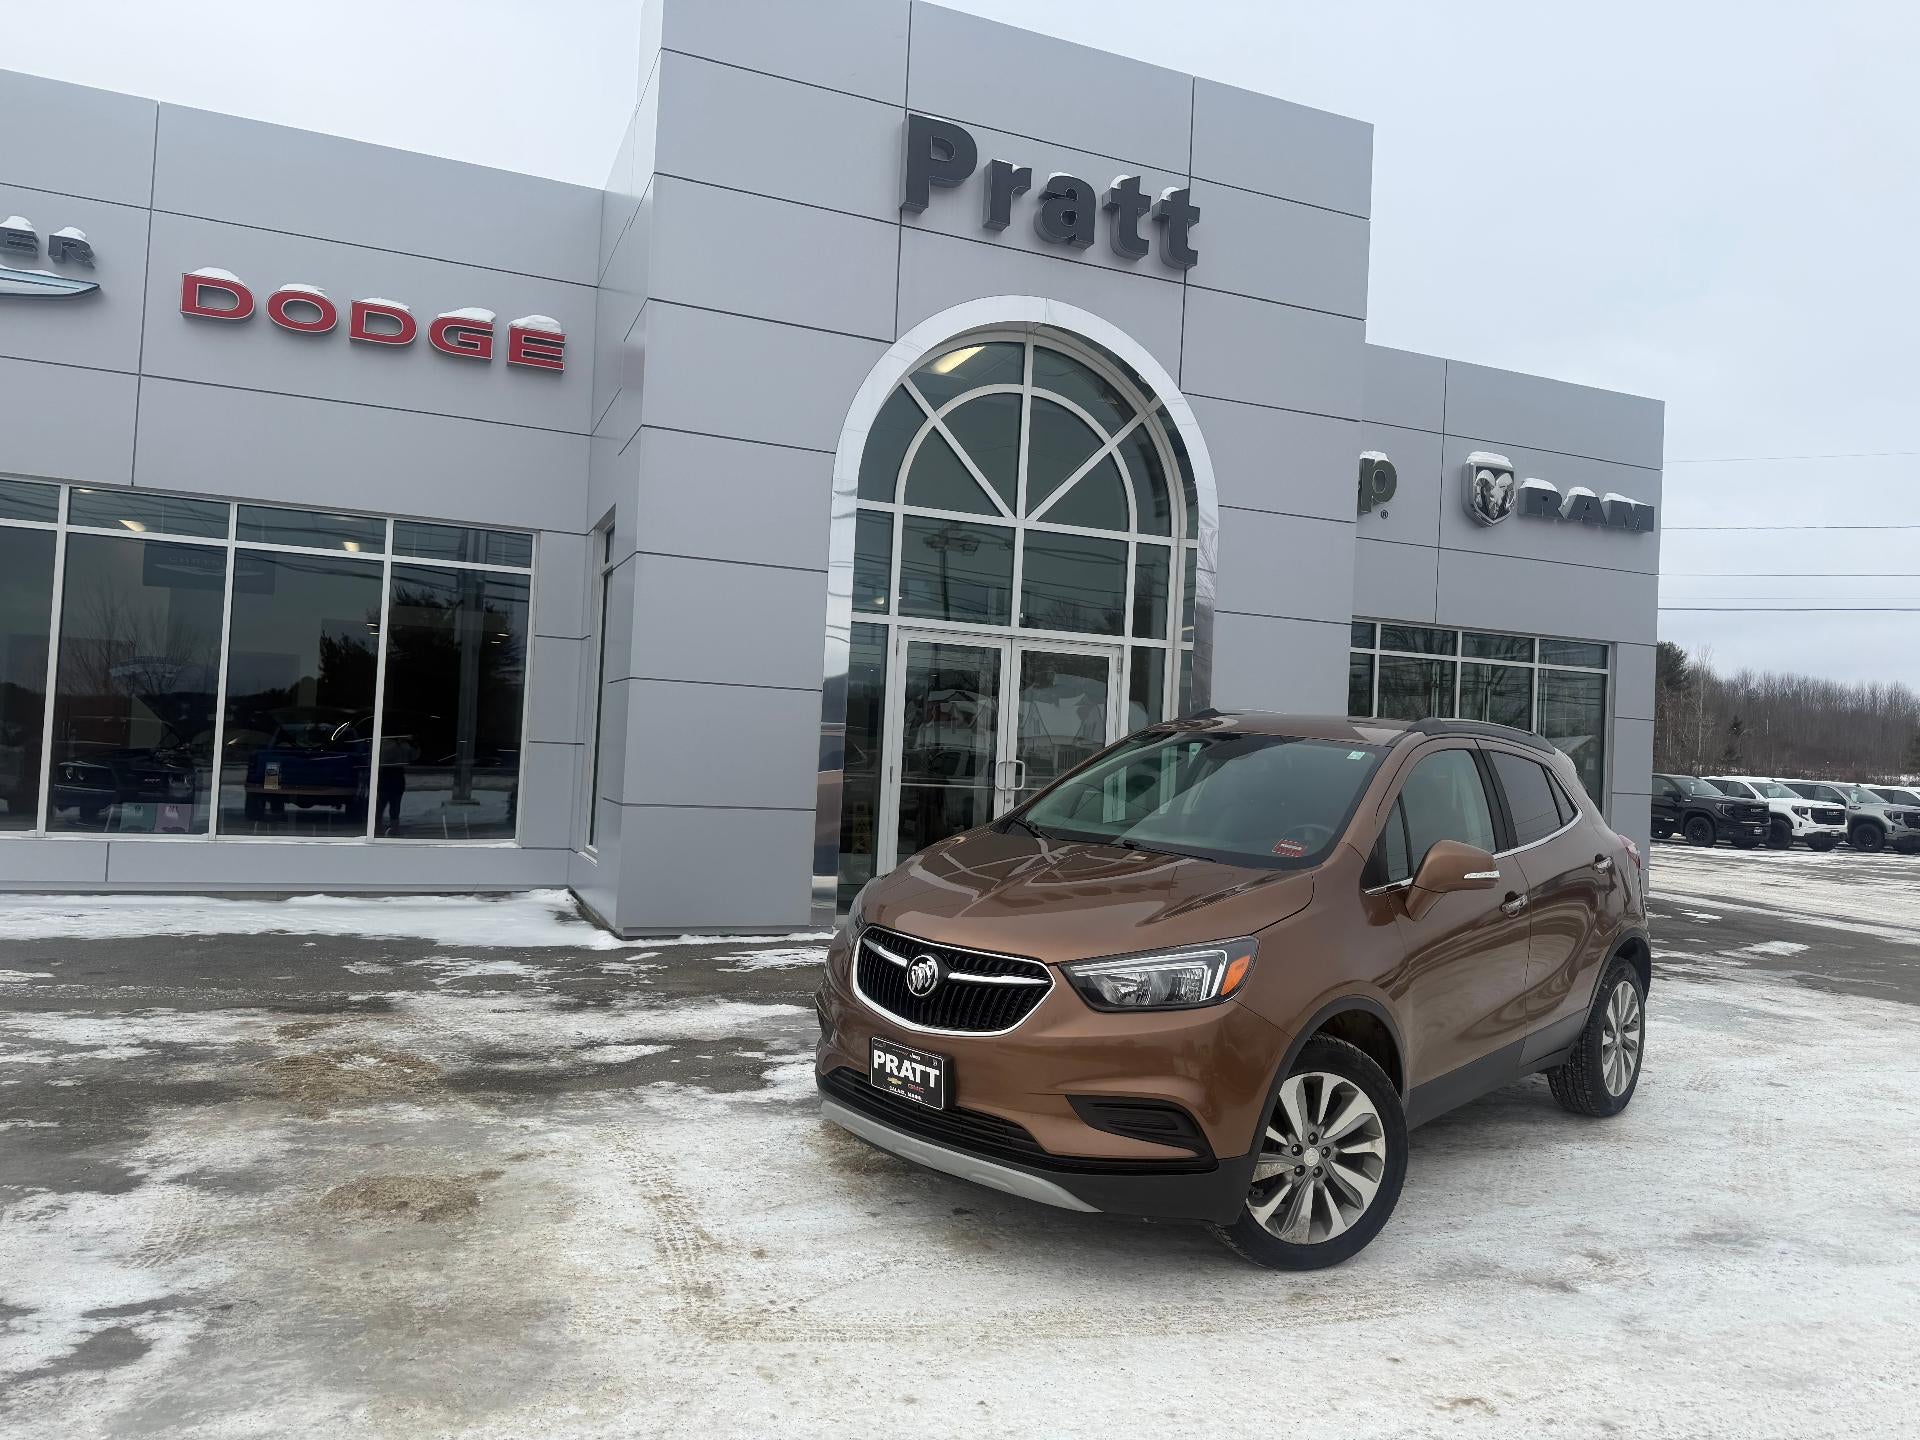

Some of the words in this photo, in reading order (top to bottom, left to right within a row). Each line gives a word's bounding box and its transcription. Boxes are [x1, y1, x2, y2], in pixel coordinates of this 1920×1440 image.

[900, 113, 1200, 270] Pratt
[180, 271, 566, 374] DODGE
[1518, 485, 1655, 533] RAM
[873, 1049, 940, 1088] PRATT
